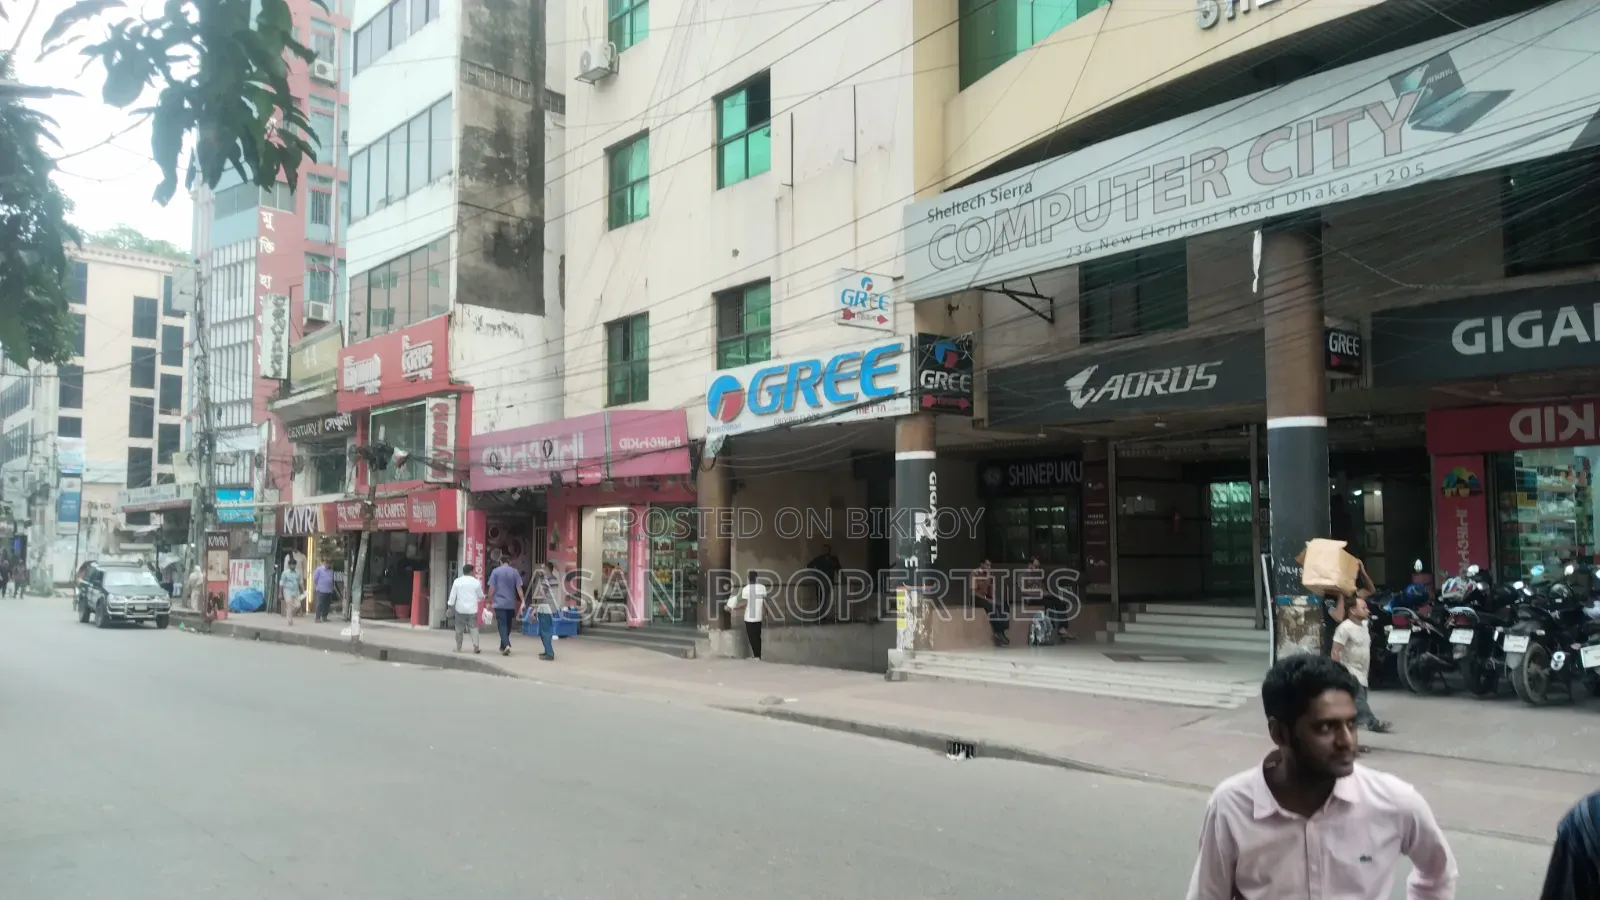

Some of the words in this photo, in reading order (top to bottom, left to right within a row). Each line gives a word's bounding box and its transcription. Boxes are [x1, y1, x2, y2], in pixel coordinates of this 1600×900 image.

[928, 146, 1232, 271] COMPUTER
[1247, 88, 1425, 186] CITY
[927, 194, 986, 224] Sheltech
[990, 182, 1033, 205] Sierra
[1066, 244, 1093, 259] 236
[1099, 234, 1132, 251] New
[1141, 213, 1219, 241] Elephant
[1229, 196, 1275, 220] Road
[1286, 180, 1350, 207] Dhaka
[840, 287, 890, 312] GREE
[1328, 331, 1360, 357] GREE
[1452, 302, 1600, 356] GIGA
[747, 342, 904, 416] GREE
[920, 369, 972, 394] GREE
[1091, 359, 1224, 403] AORUS
[287, 422, 318, 439] CENTURY
[208, 535, 229, 548] KAYRA
